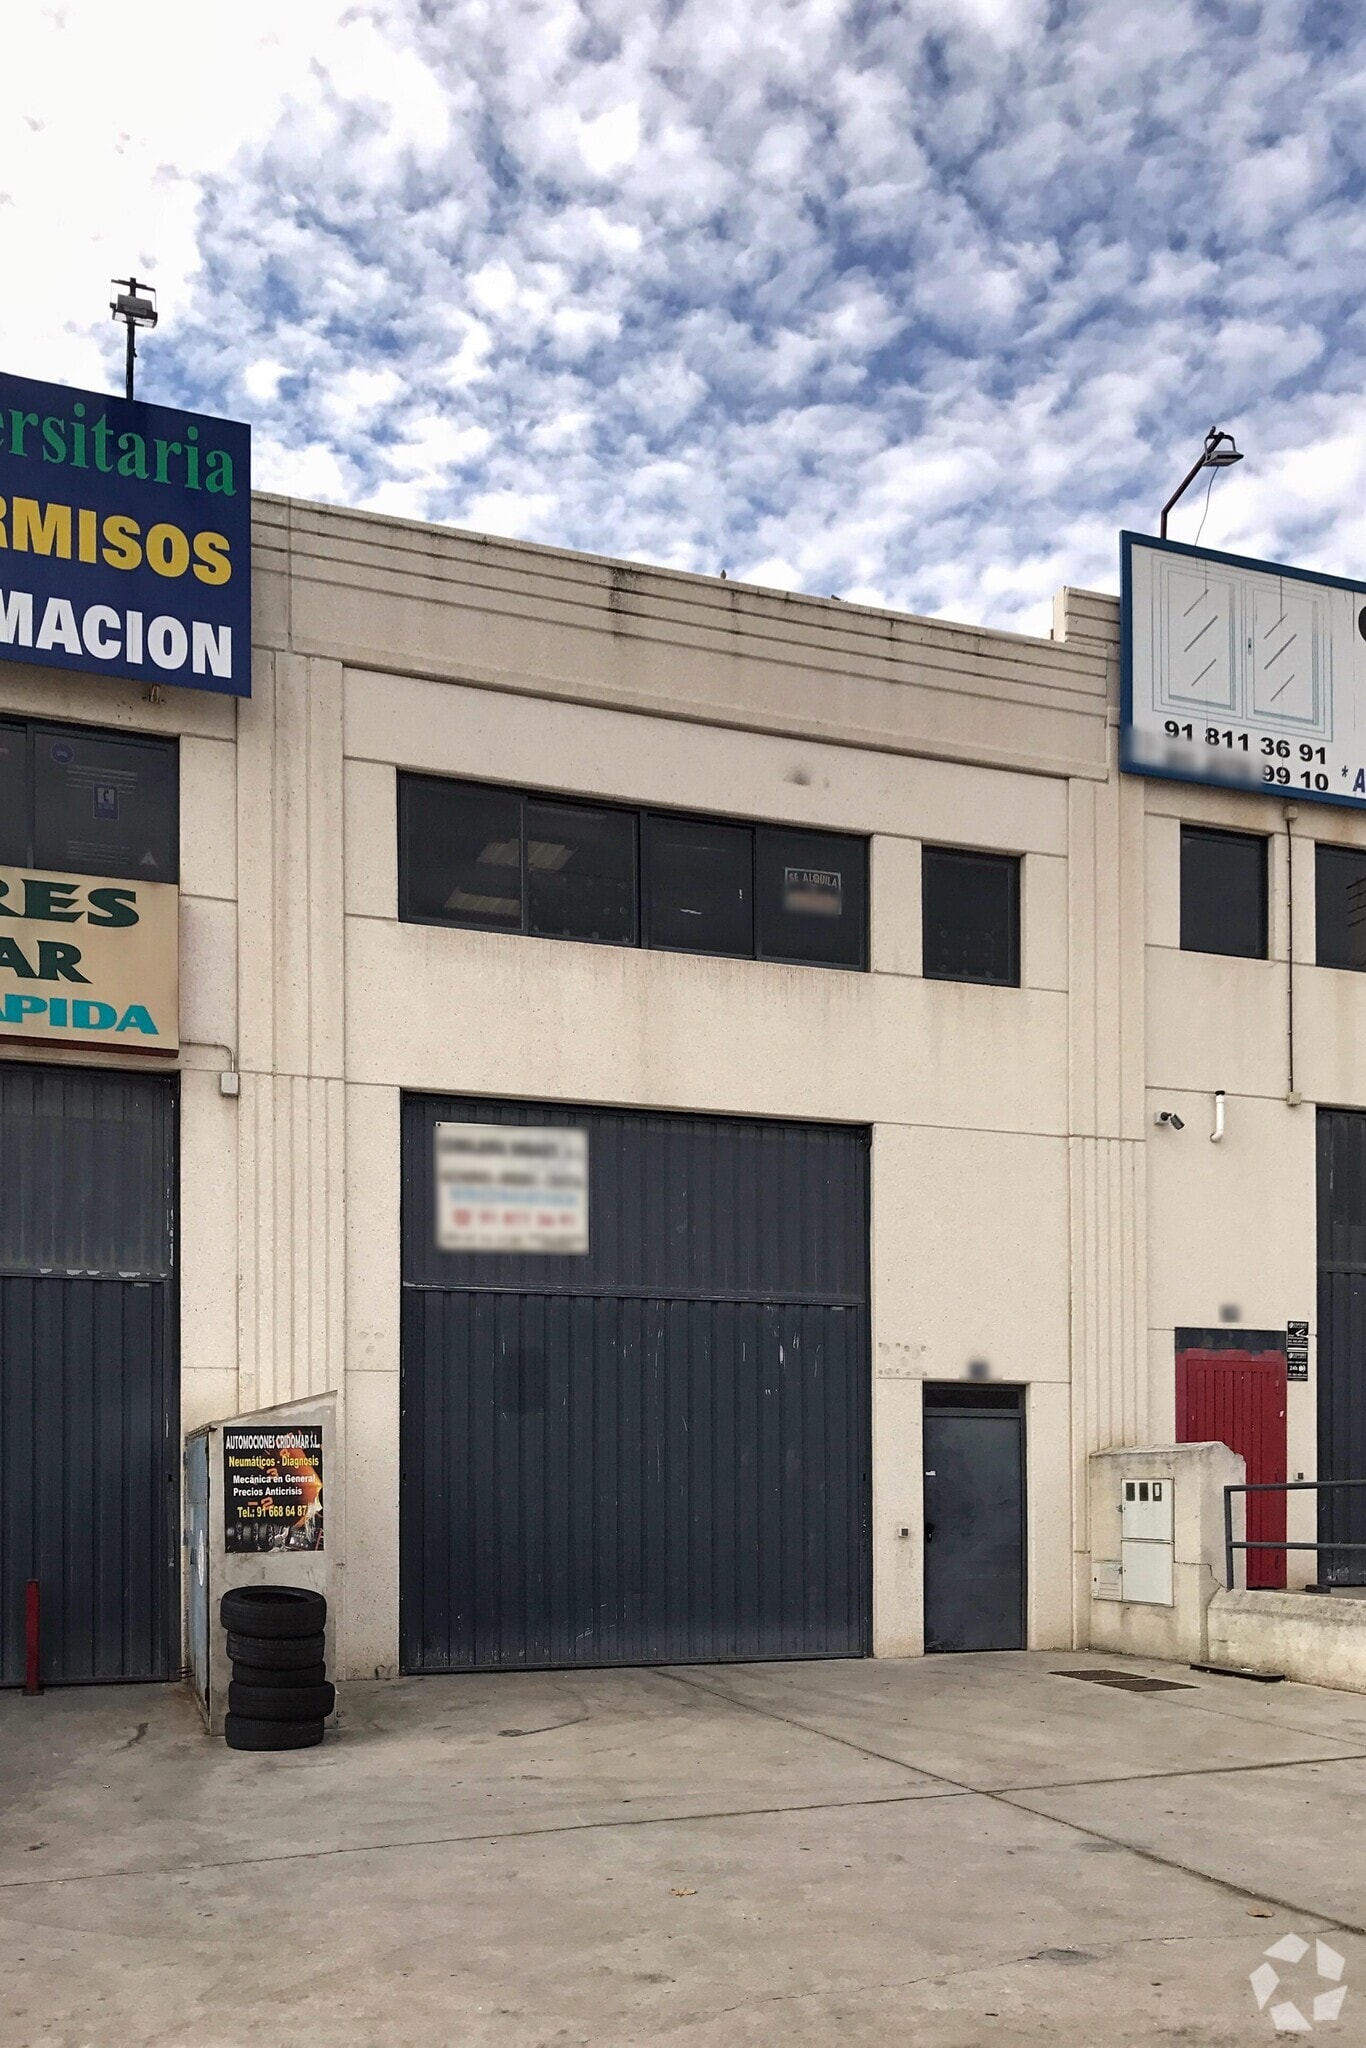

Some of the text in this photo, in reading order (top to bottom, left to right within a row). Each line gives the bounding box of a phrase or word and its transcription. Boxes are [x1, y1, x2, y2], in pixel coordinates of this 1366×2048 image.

[0, 402, 237, 496] rsitaria
[1164, 720, 1326, 765] 91 811 36 91
[1300, 771, 1329, 792] 10
[802, 872, 838, 888] ALQUILA
[0, 993, 160, 1035] PIDA
[226, 1435, 275, 1450] AUTOMOCIONES
[276, 1435, 309, 1449] CRIDOMAR
[228, 1455, 276, 1467] Neumáticos
[281, 1454, 319, 1468] Diagnosis
[232, 1475, 272, 1484] Mecánica
[284, 1474, 316, 1483] General
[233, 1486, 303, 1497] Precios Anticrisis
[256, 1506, 266, 1517] 91
[268, 1505, 283, 1517] 668
[285, 1505, 295, 1517] 64
[297, 1505, 307, 1517] 87
